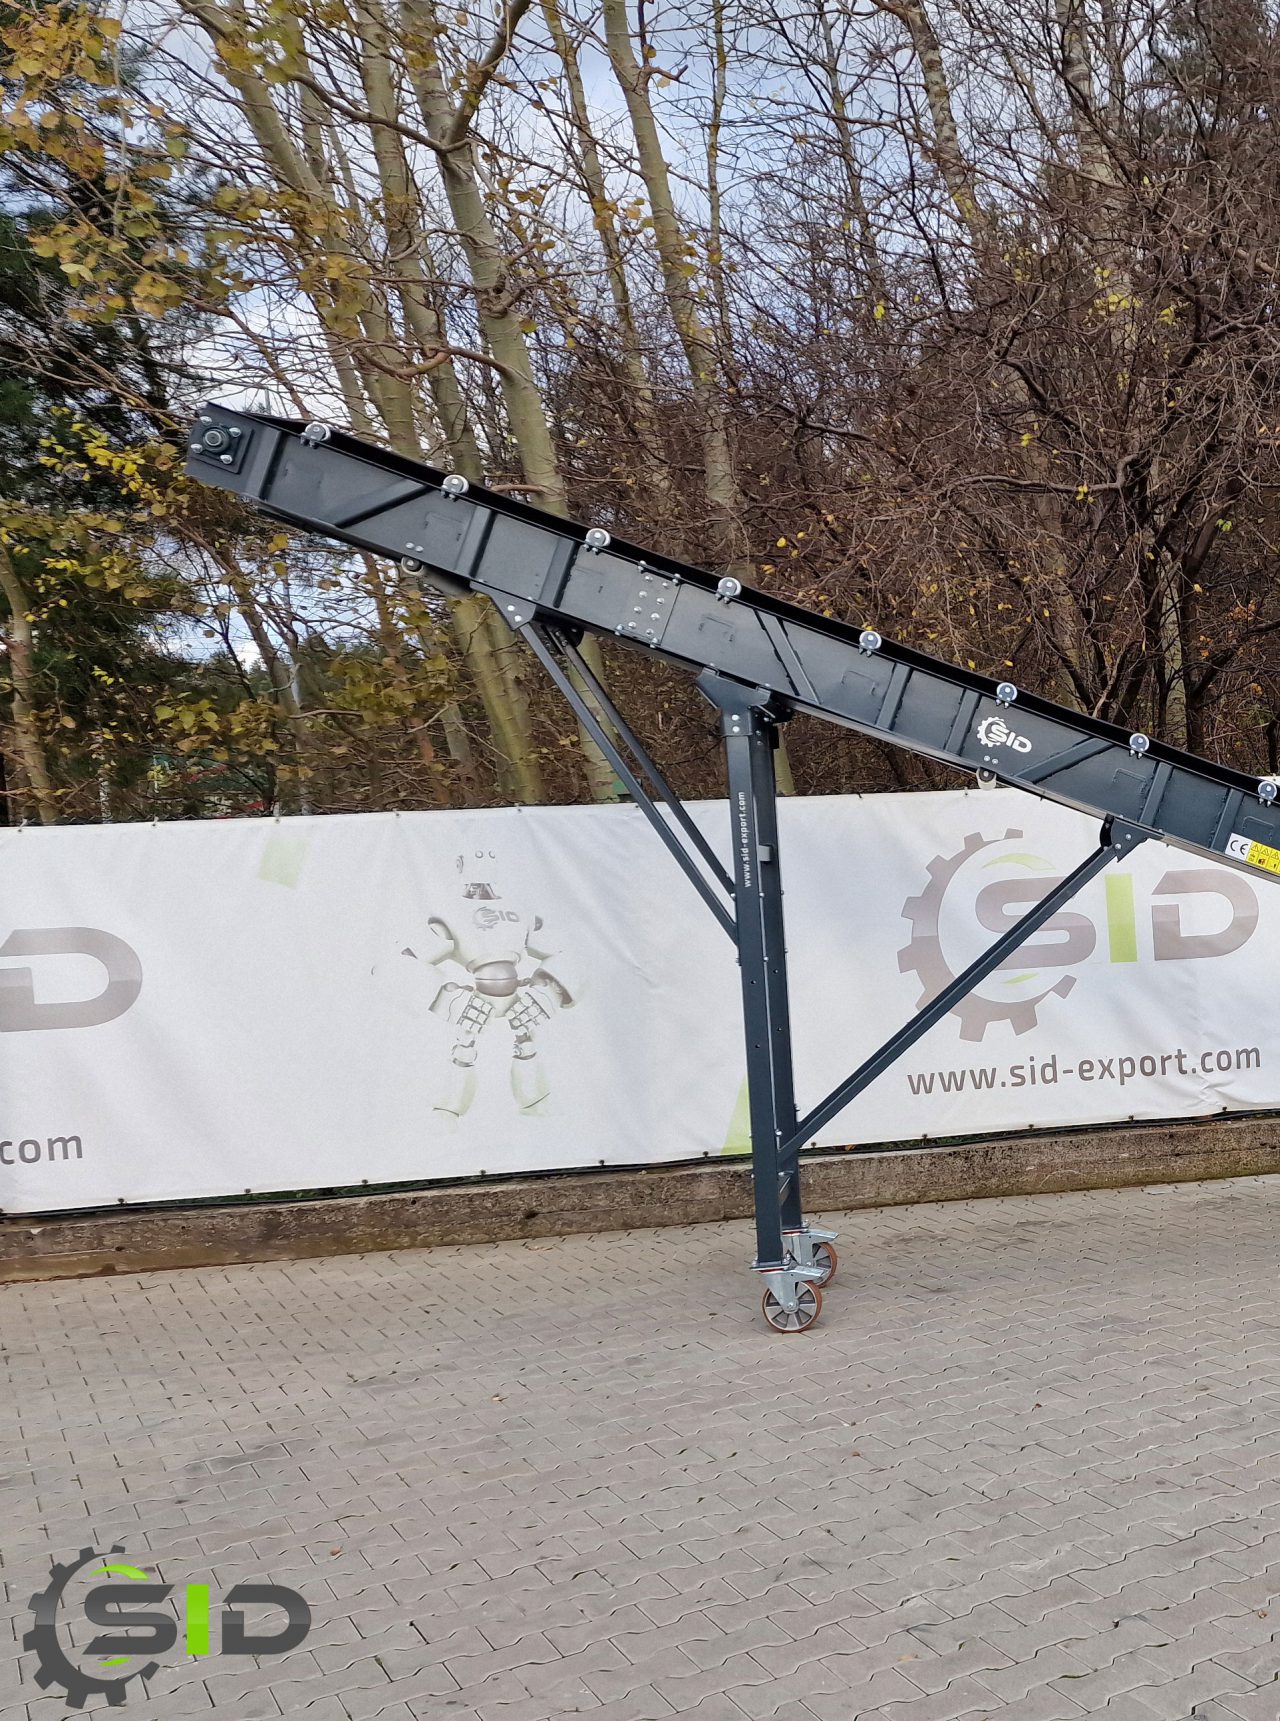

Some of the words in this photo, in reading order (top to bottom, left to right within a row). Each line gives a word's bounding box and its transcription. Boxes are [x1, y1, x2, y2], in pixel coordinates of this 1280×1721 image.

[988, 724, 1032, 753] SID
[738, 791, 752, 888] www.sid-export.com
[974, 868, 1259, 971] SID
[907, 1046, 1262, 1095] www.sid-export.com
